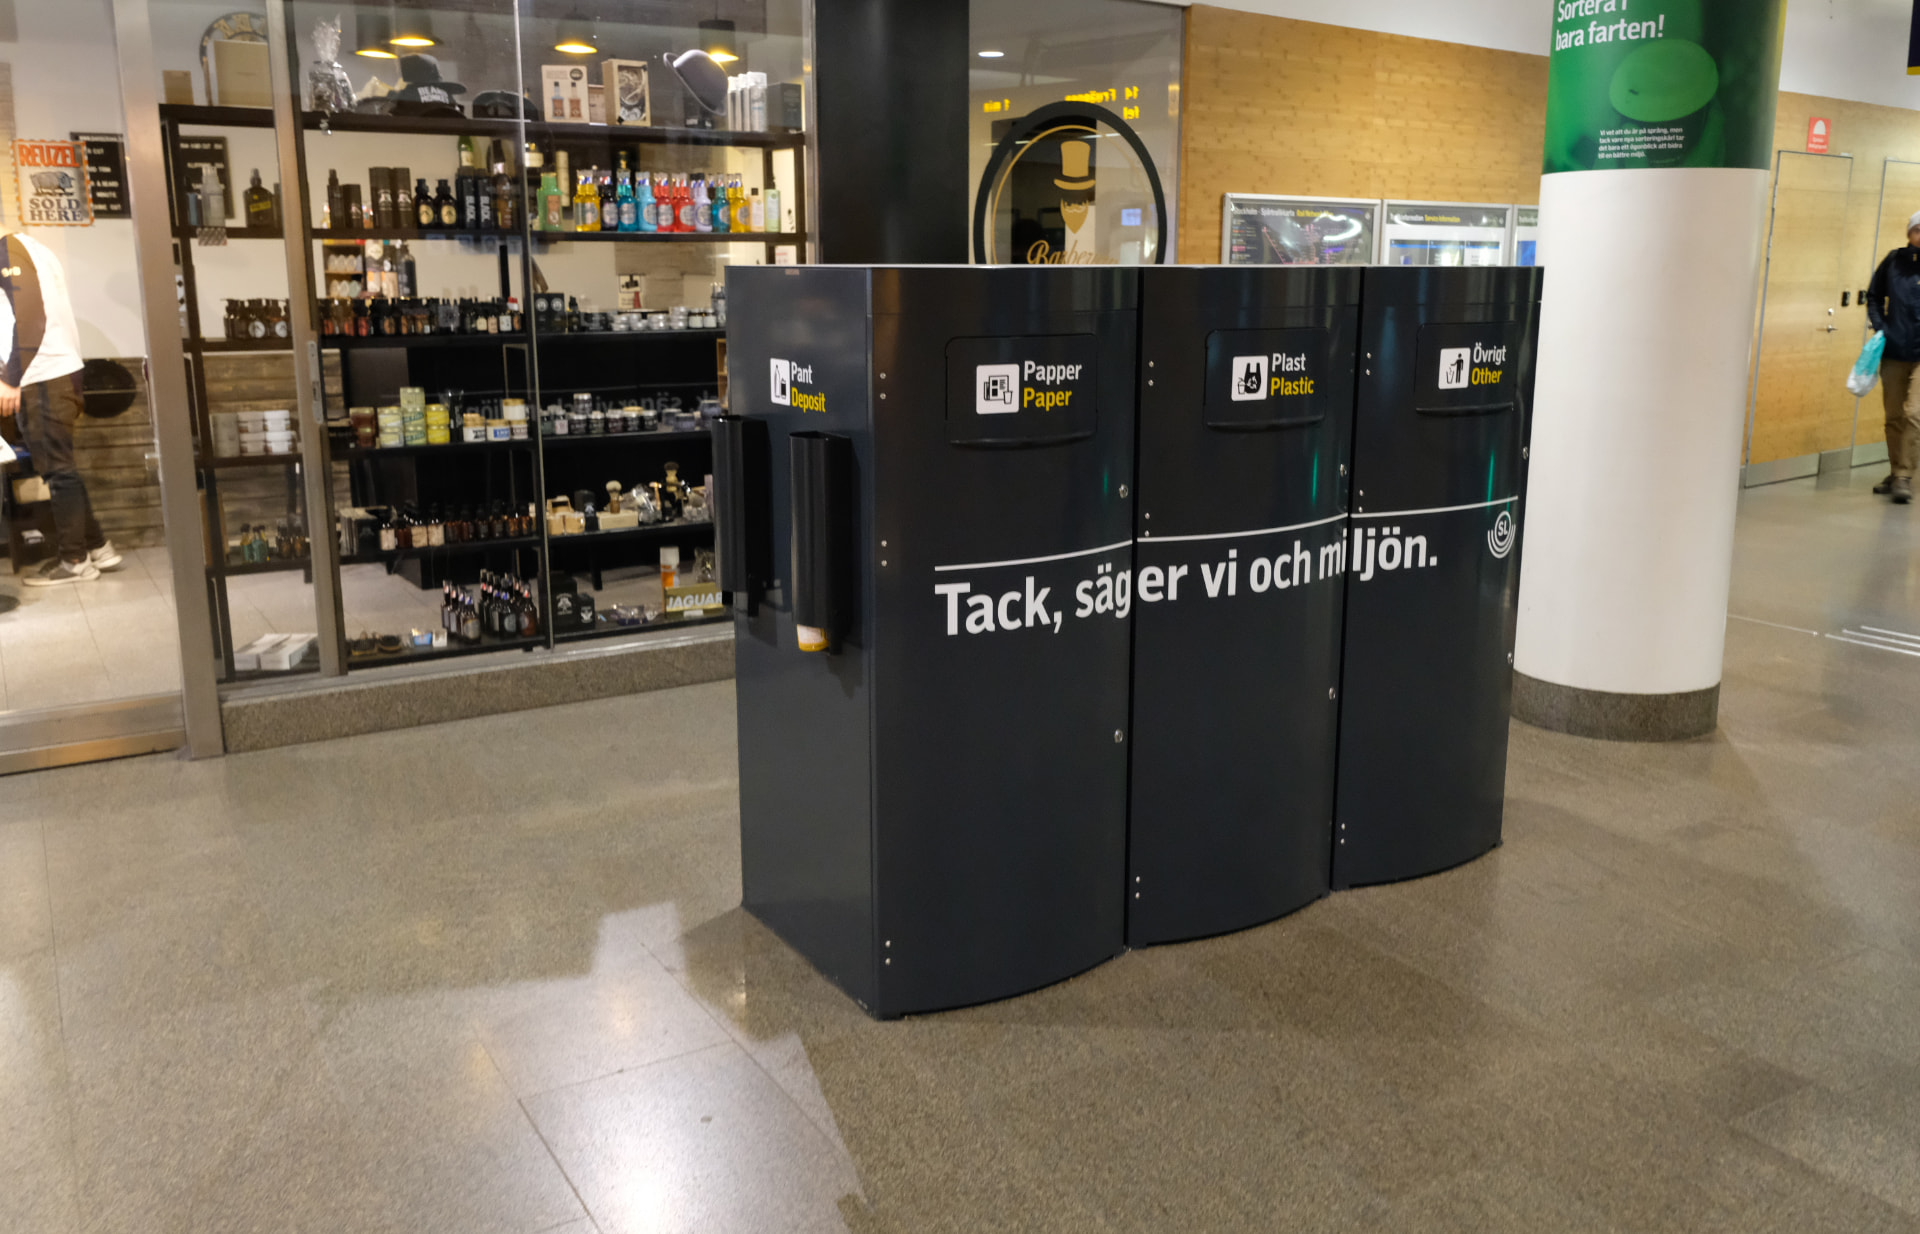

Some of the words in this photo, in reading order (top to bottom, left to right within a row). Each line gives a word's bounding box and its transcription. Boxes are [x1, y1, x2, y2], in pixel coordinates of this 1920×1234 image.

[1557, 0, 1616, 22] Sortera
[1555, 29, 1585, 51] bara
[1588, 14, 1665, 44] farten!
[18, 144, 80, 168] REUZEL
[29, 198, 81, 210] SOLD
[30, 210, 84, 222] HERE
[1271, 352, 1306, 373] Plast
[1472, 342, 1506, 367] Övrigt
[790, 360, 813, 386] Pant
[1023, 360, 1083, 386] Papper
[1470, 367, 1503, 386] Other
[1270, 376, 1315, 397] Plastic
[791, 387, 827, 414] Deposit
[1023, 387, 1073, 412] Paper
[1497, 521, 1511, 537] SL
[934, 575, 1063, 636] Tack,
[1074, 561, 1188, 619] säger
[1200, 549, 1237, 599] vi
[1249, 540, 1311, 594] och
[1319, 525, 1439, 583] miljön.
